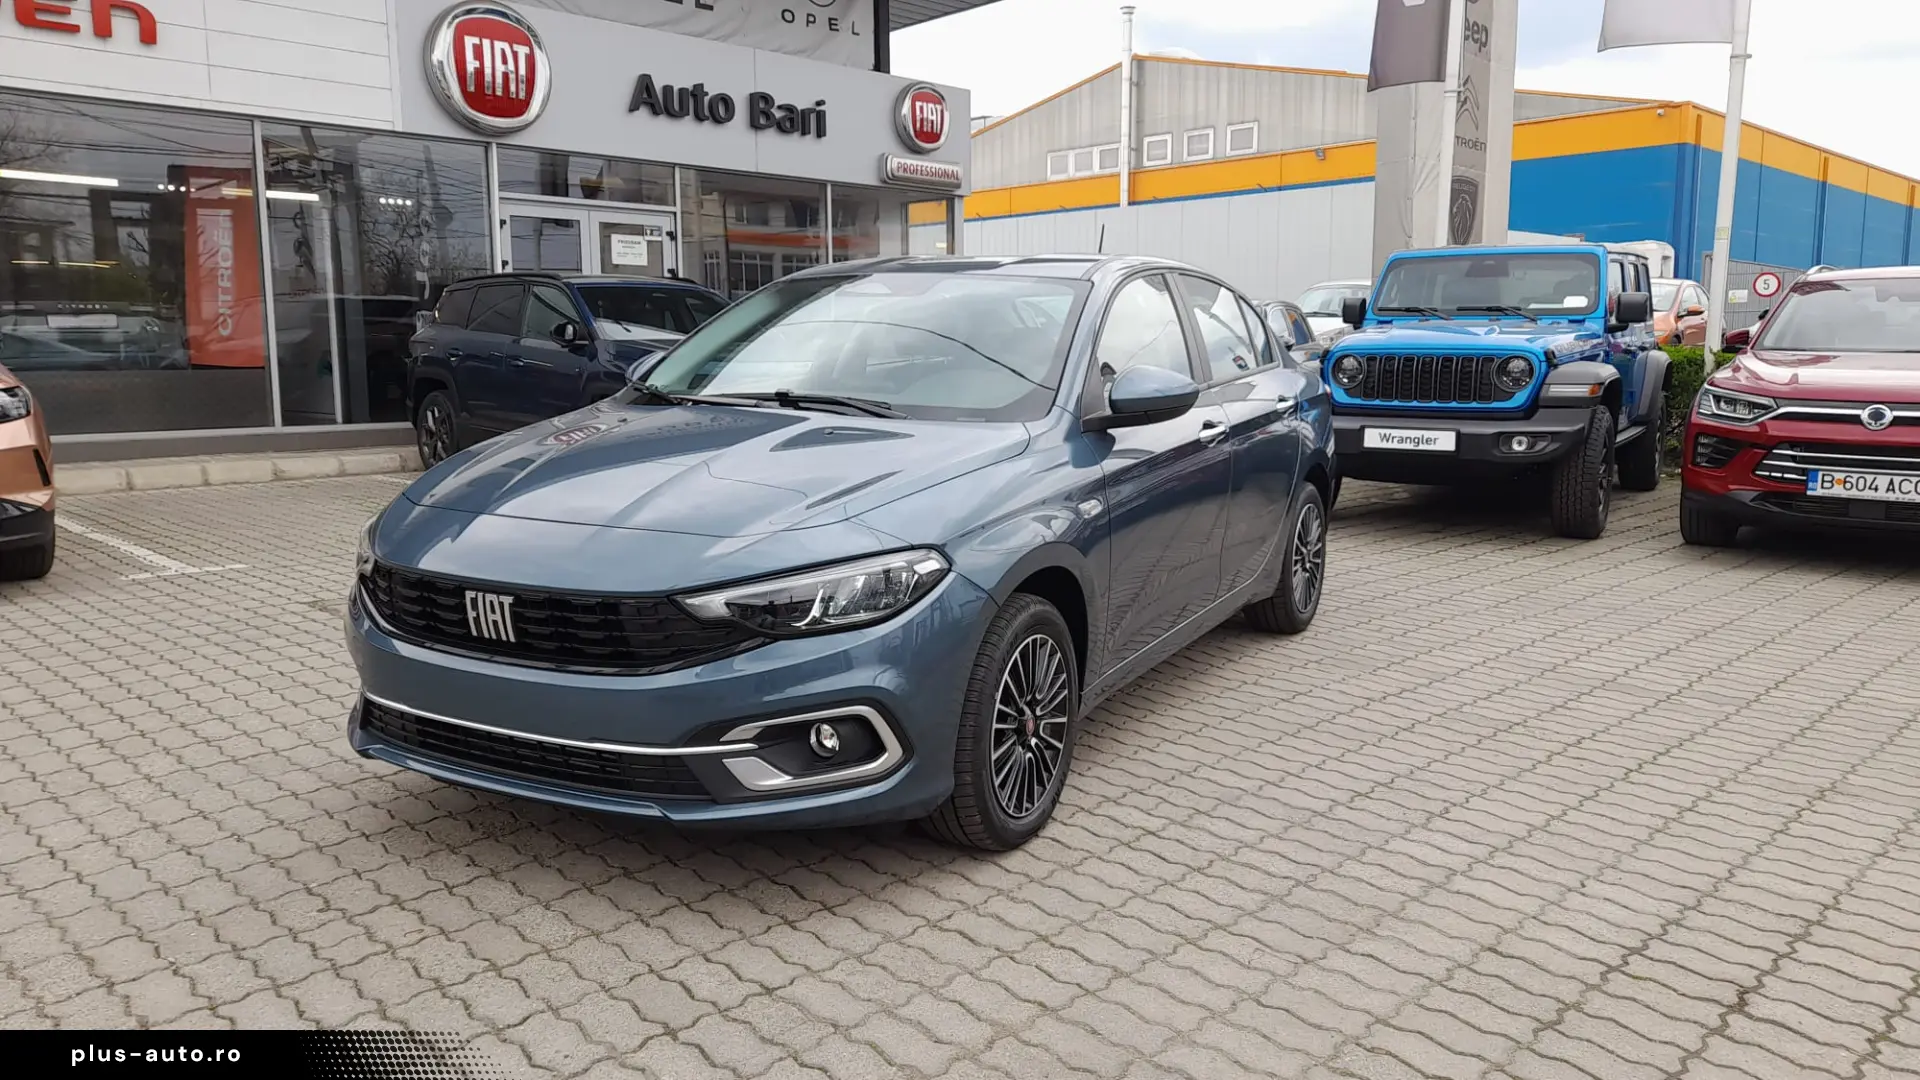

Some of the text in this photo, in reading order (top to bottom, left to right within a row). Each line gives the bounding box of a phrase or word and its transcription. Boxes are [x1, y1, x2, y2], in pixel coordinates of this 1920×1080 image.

[780, 8, 860, 36] OPEL
[463, 35, 530, 100] FIAT
[628, 73, 827, 138] Auto Bari
[915, 101, 942, 133] FIAT
[896, 161, 960, 181] PROFESSIONAL
[1763, 279, 1770, 290] 5
[1379, 432, 1439, 447] Wrangler
[1821, 473, 1835, 489] B
[1843, 475, 1879, 493] 604
[465, 590, 516, 642] FIAT
